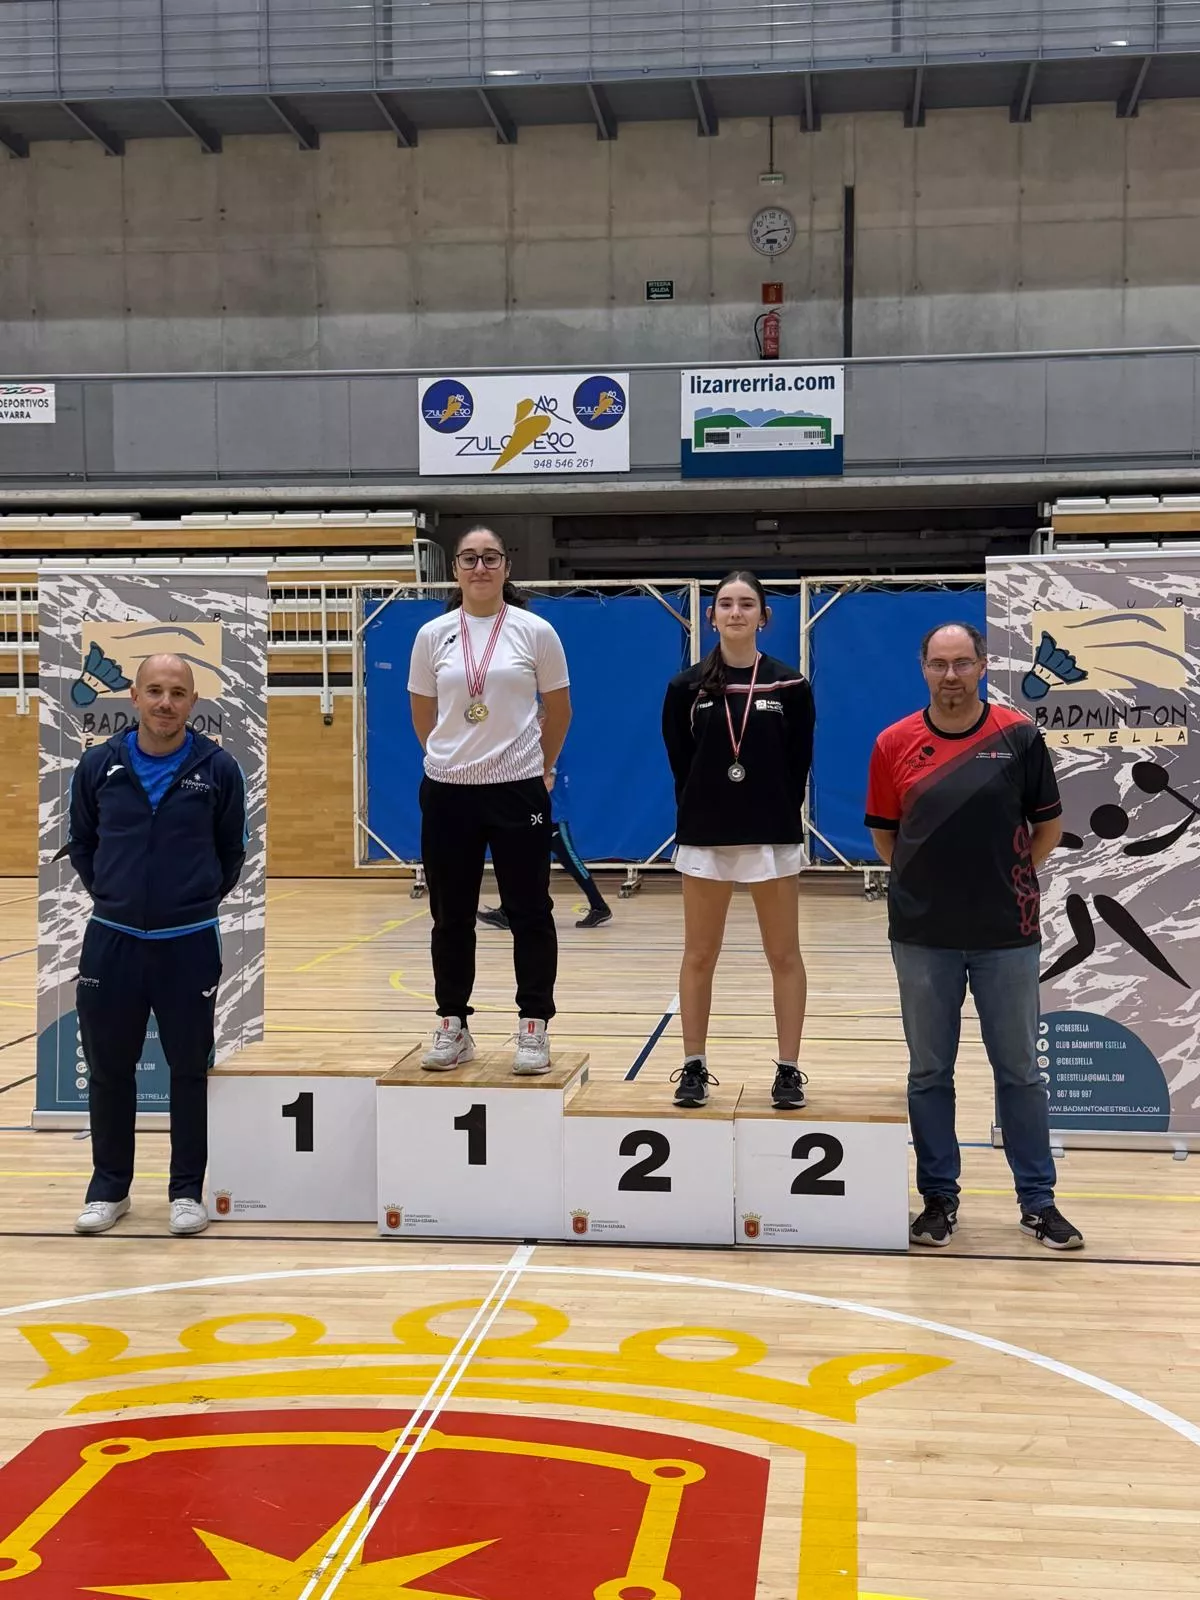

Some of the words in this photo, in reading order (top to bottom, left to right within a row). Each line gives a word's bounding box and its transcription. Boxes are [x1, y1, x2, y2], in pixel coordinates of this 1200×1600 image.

[690, 373, 835, 394] lizarrerria.com
[0, 398, 48, 408] DEPORTIVOS
[534, 459, 552, 469] 948
[554, 459, 573, 468] 546
[577, 458, 594, 468] 261
[1033, 598, 1184, 611] CLUB
[82, 612, 222, 622] CLUB
[82, 712, 222, 733] BADON
[1035, 704, 1187, 728] BADMINTON
[282, 1092, 313, 1152] 1
[454, 1104, 486, 1165] 1
[618, 1130, 671, 1192] 2
[791, 1133, 845, 1196] 2
